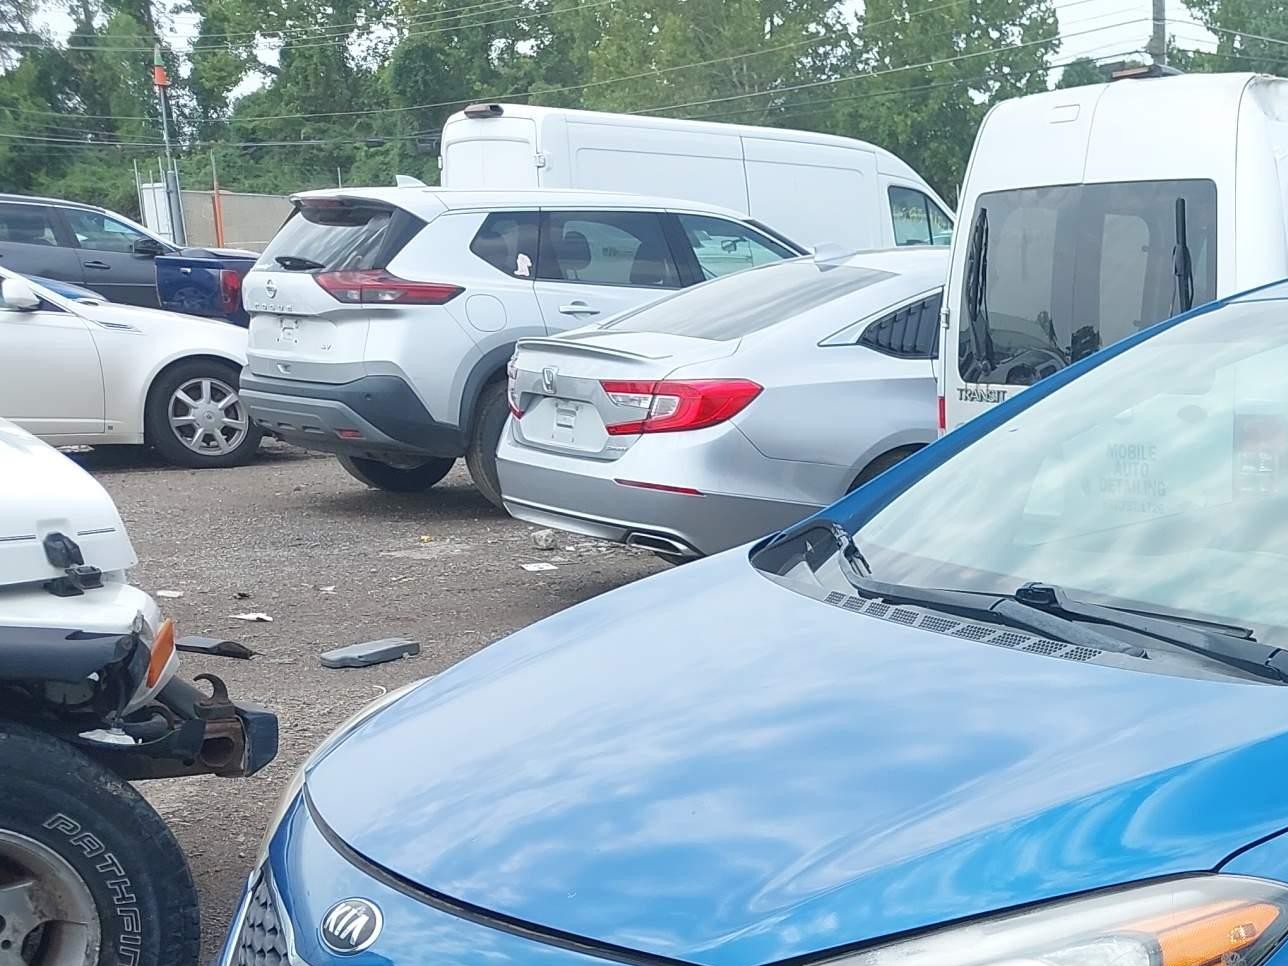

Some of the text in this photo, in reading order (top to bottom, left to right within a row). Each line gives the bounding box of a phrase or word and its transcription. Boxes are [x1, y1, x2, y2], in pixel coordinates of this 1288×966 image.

[957, 388, 1008, 404] TRANSIT
[1106, 443, 1158, 461] MOBILE
[1113, 461, 1150, 479] AUTO
[1099, 478, 1168, 497] DETAILING
[323, 902, 370, 946] KIA
